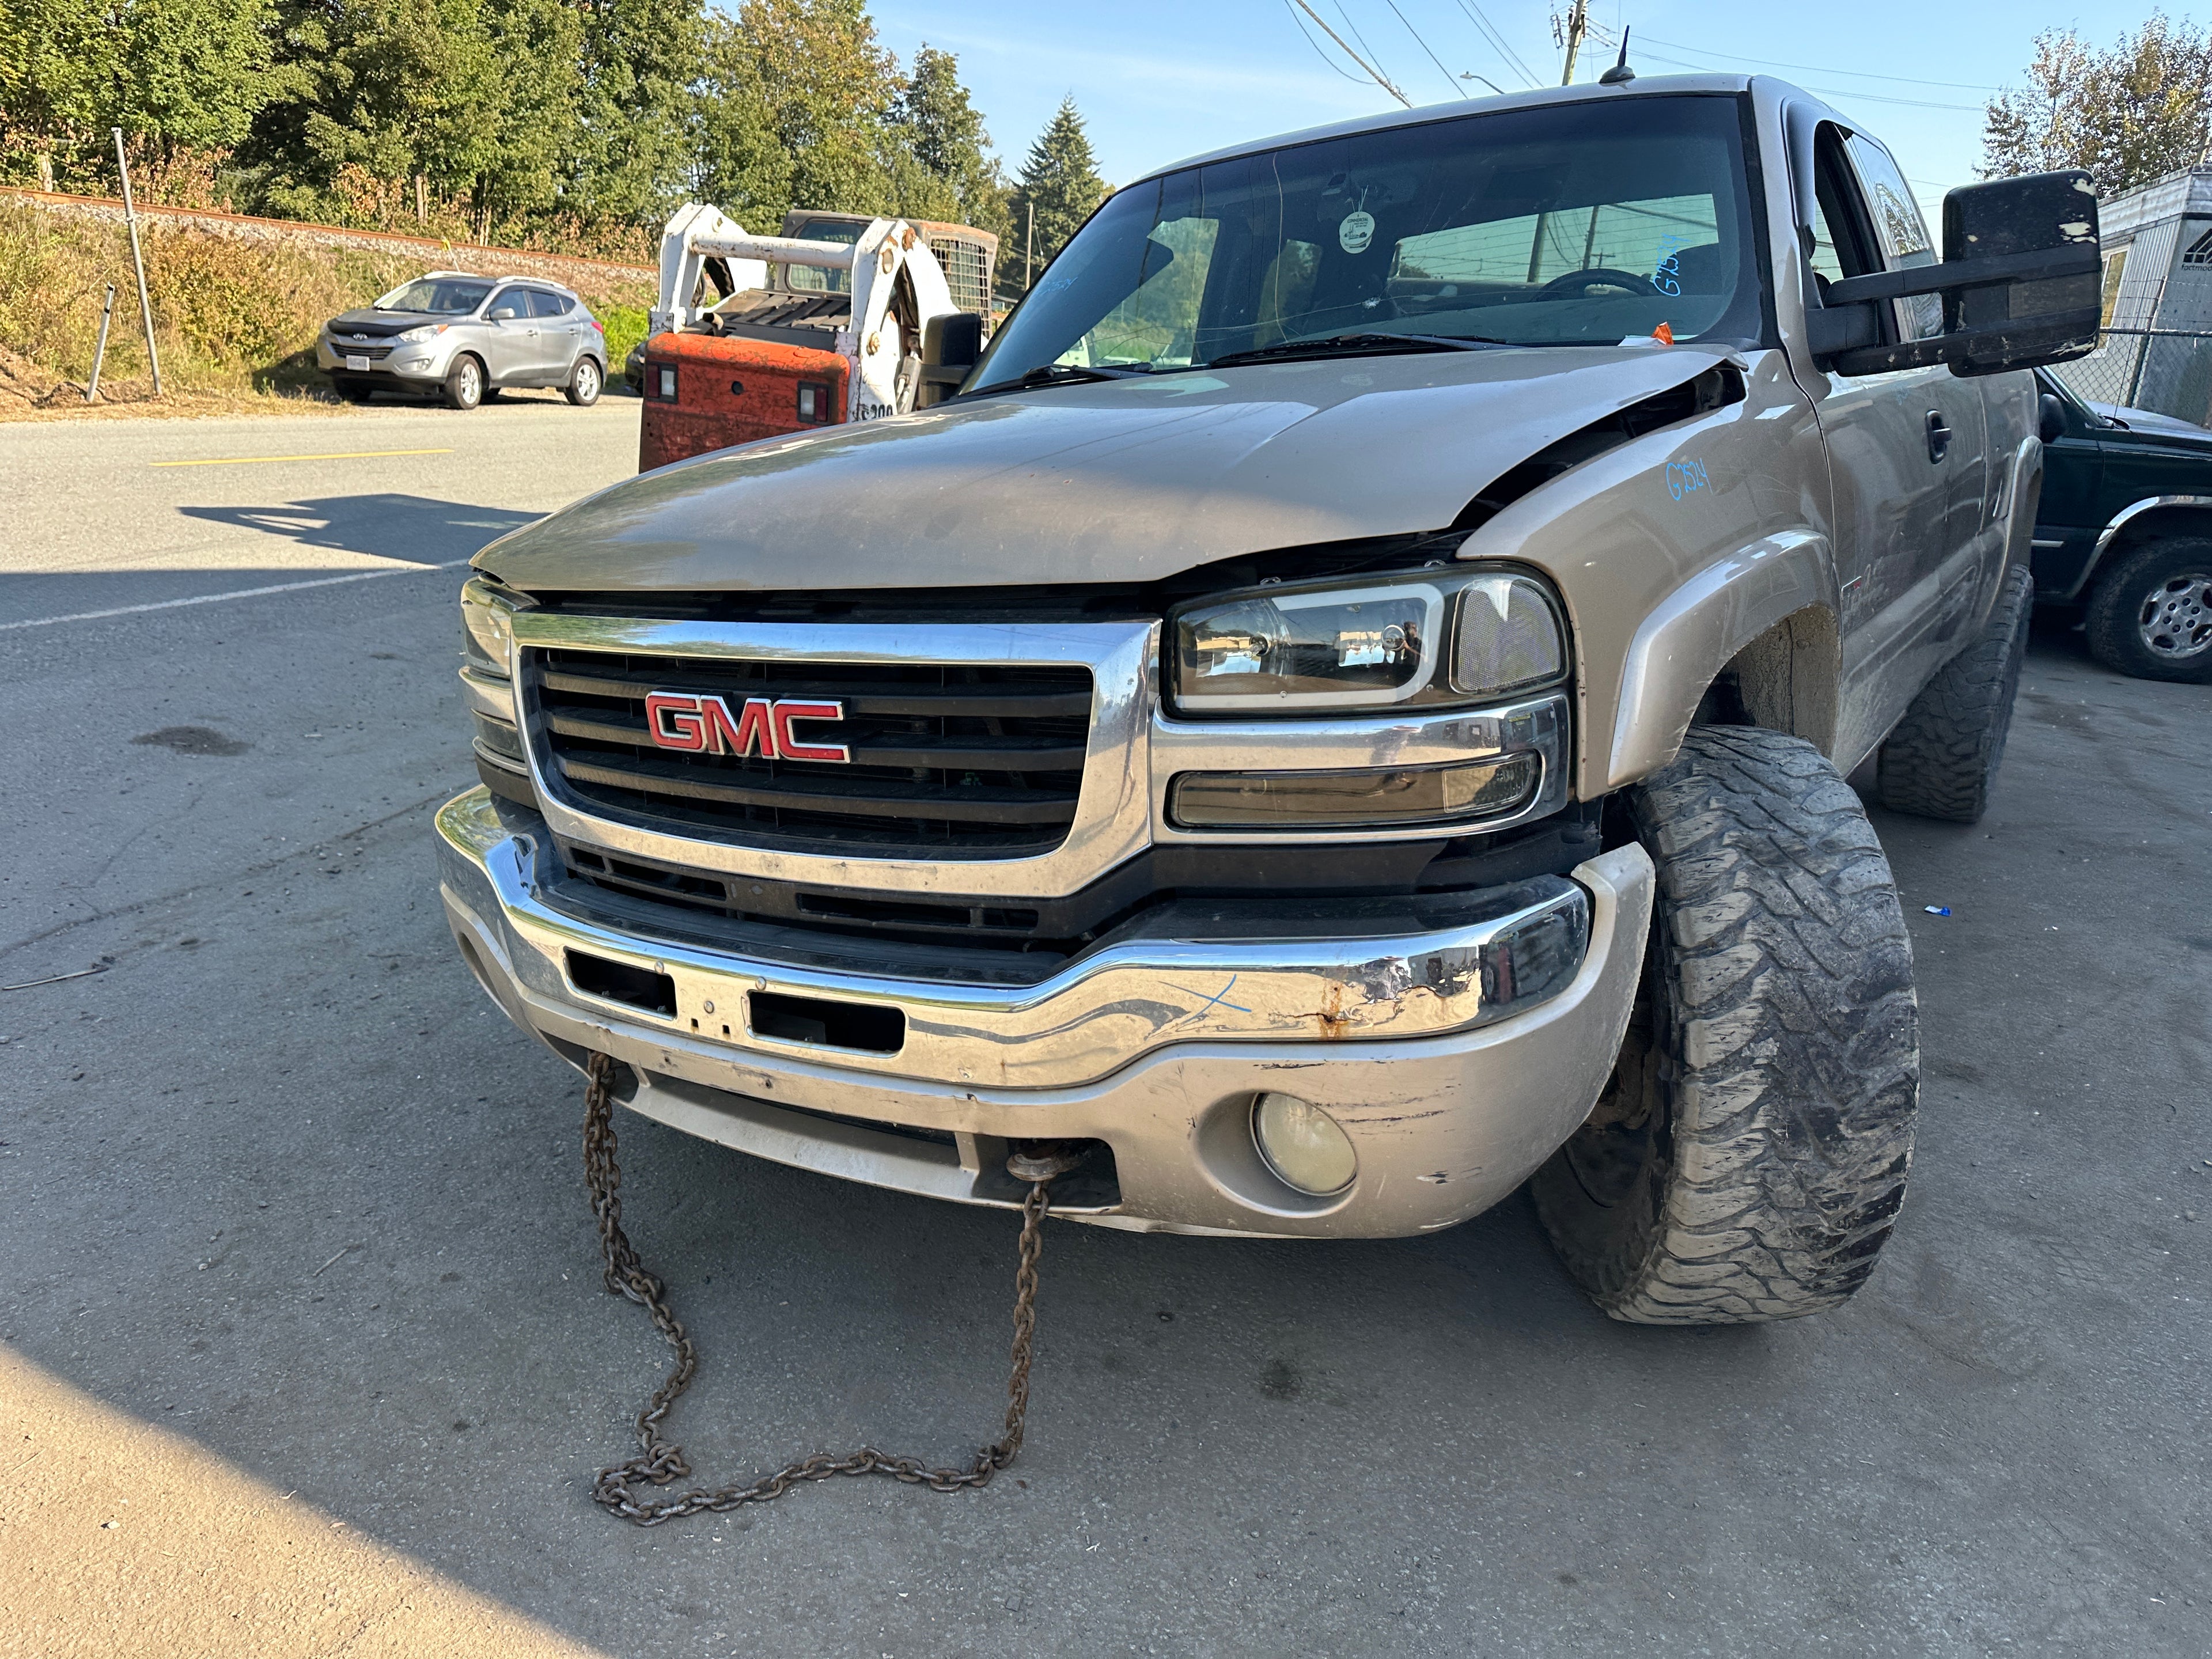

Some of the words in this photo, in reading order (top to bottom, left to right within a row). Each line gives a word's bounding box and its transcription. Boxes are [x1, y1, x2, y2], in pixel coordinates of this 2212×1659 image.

[1653, 233, 1692, 296] G2524
[1666, 457, 1713, 501] G2524
[645, 691, 851, 764] GMC
